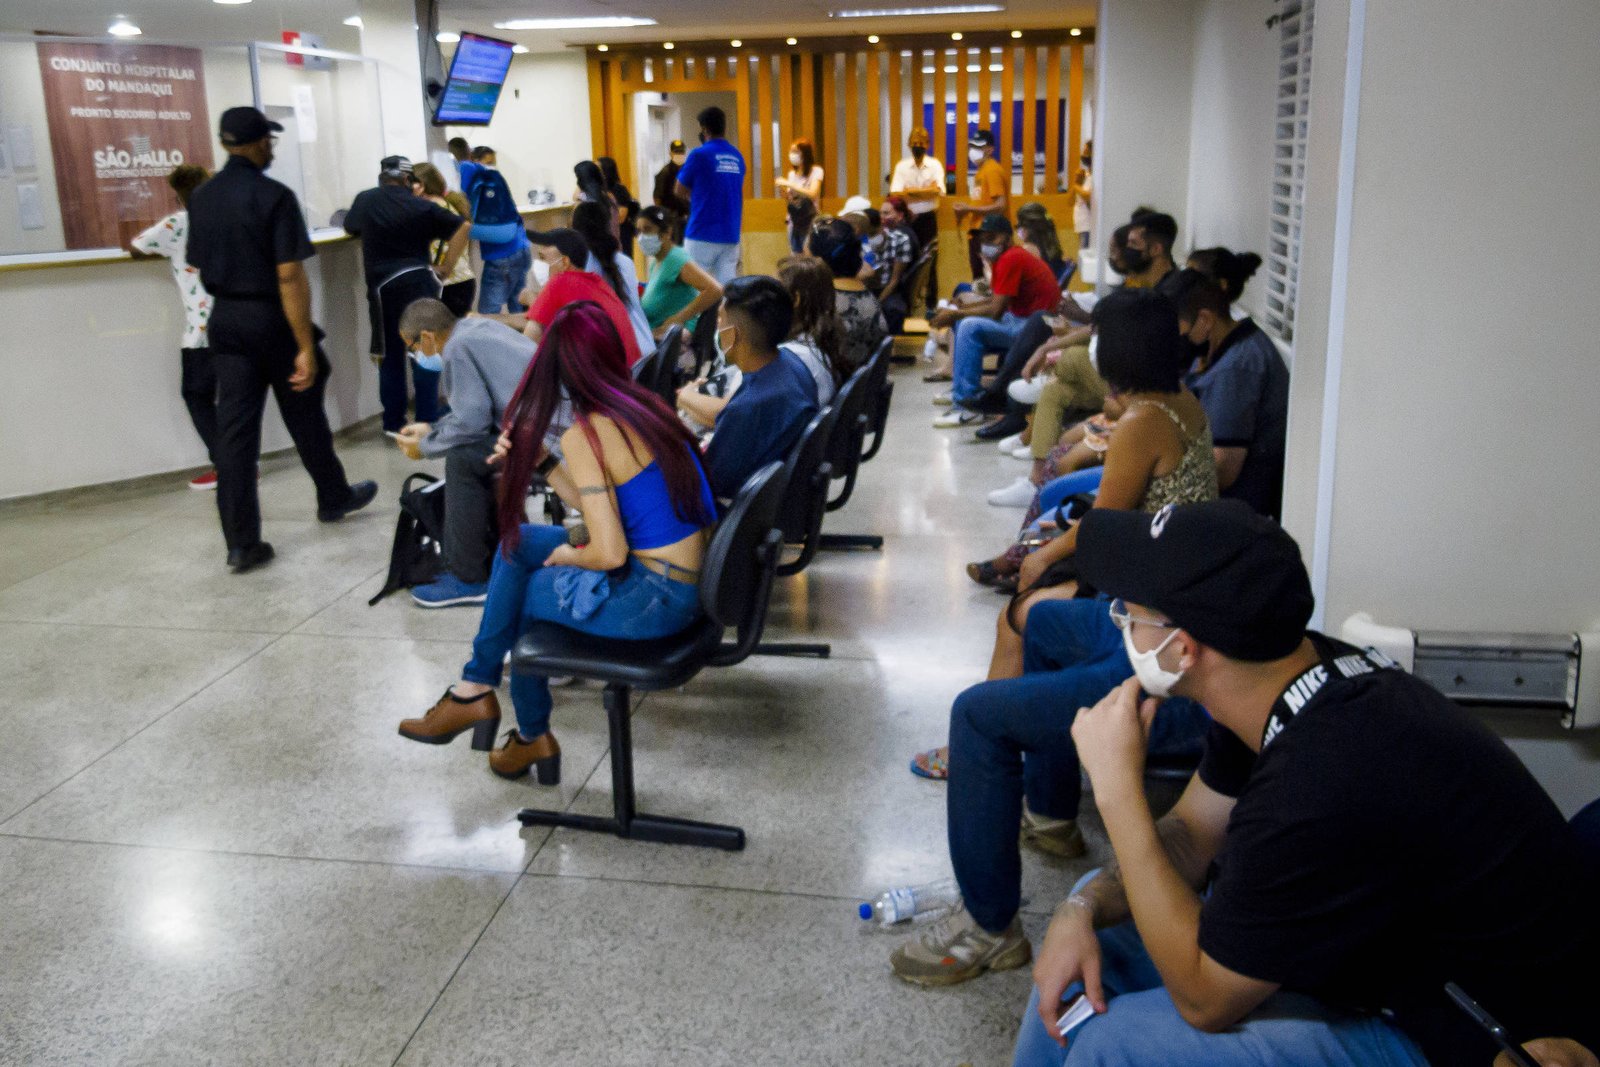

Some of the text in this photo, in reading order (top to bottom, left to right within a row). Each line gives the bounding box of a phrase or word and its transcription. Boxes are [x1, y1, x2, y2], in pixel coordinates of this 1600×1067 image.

[50, 56, 196, 81] CONJUNTO HOSPITALAR
[85, 78, 174, 97] DO MANDAQUI
[70, 107, 112, 118] PRONTO
[113, 108, 157, 120] SOCORRO
[94, 144, 184, 168] SÃO PAULO
[1283, 664, 1330, 716] NIKE
